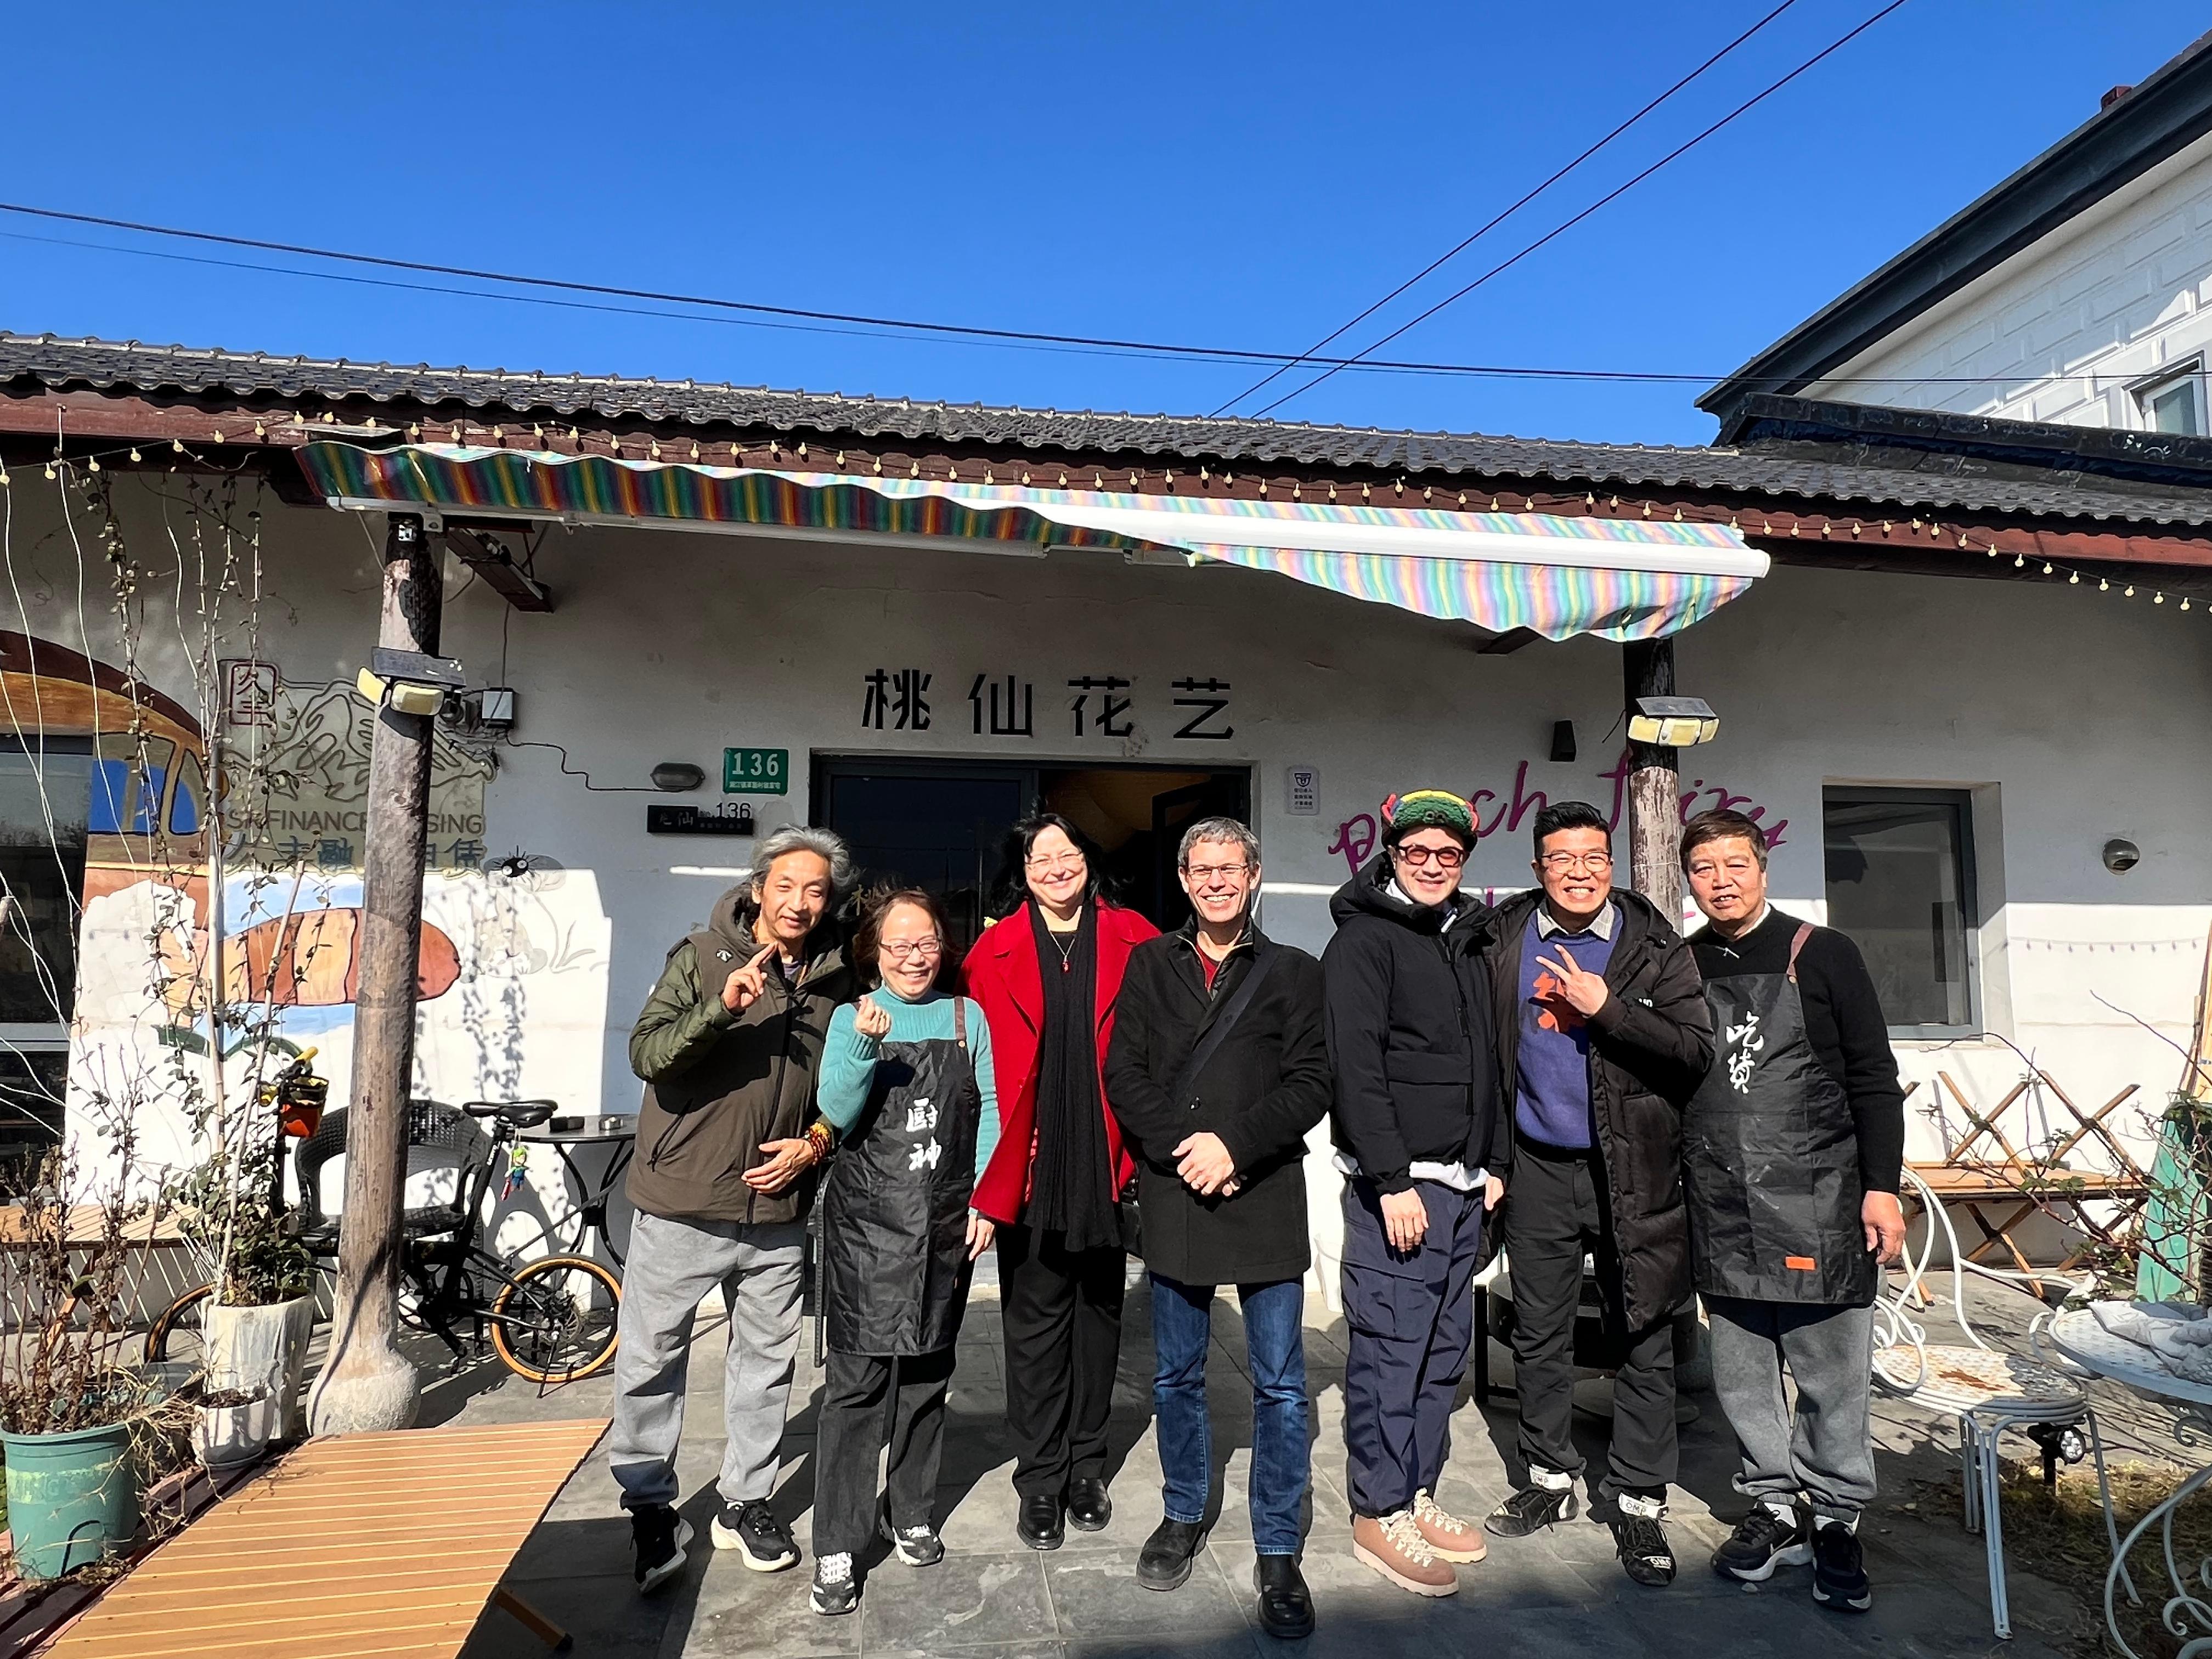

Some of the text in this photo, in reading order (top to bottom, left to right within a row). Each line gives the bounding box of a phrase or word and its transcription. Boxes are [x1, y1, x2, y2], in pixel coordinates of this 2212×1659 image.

[861, 668, 1234, 740] 桃仙花艺
[732, 753, 779, 776] 136
[1328, 760, 1547, 878] pch
[905, 1098, 942, 1171] 厨神
